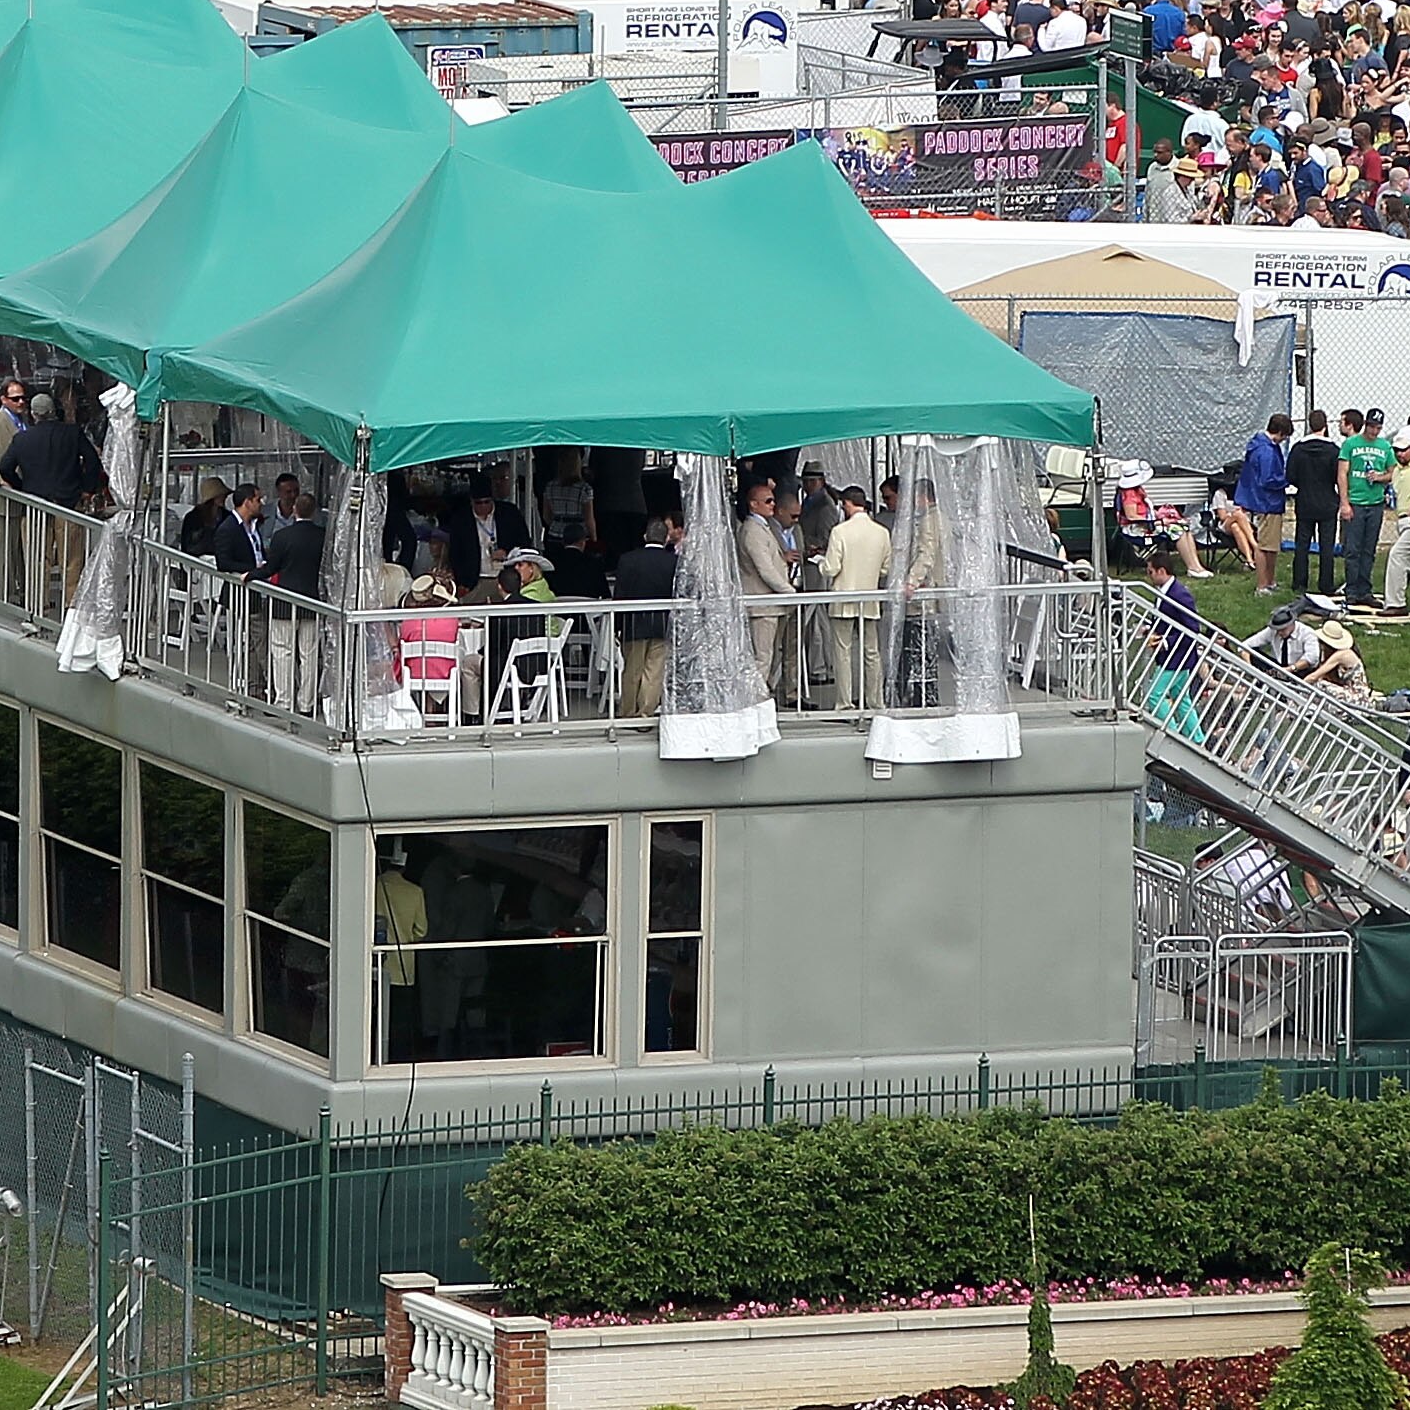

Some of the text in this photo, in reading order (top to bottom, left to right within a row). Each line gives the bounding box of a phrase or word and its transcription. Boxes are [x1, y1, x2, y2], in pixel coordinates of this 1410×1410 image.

[733, 0, 797, 42] POLAR LEASING
[924, 123, 1086, 156] PADDOCK CONCERT
[974, 154, 1039, 182] SERIES
[1254, 272, 1365, 289] RENTAL
[1255, 261, 1367, 272] REFRIGERATION
[1368, 254, 1396, 296] POLAR
